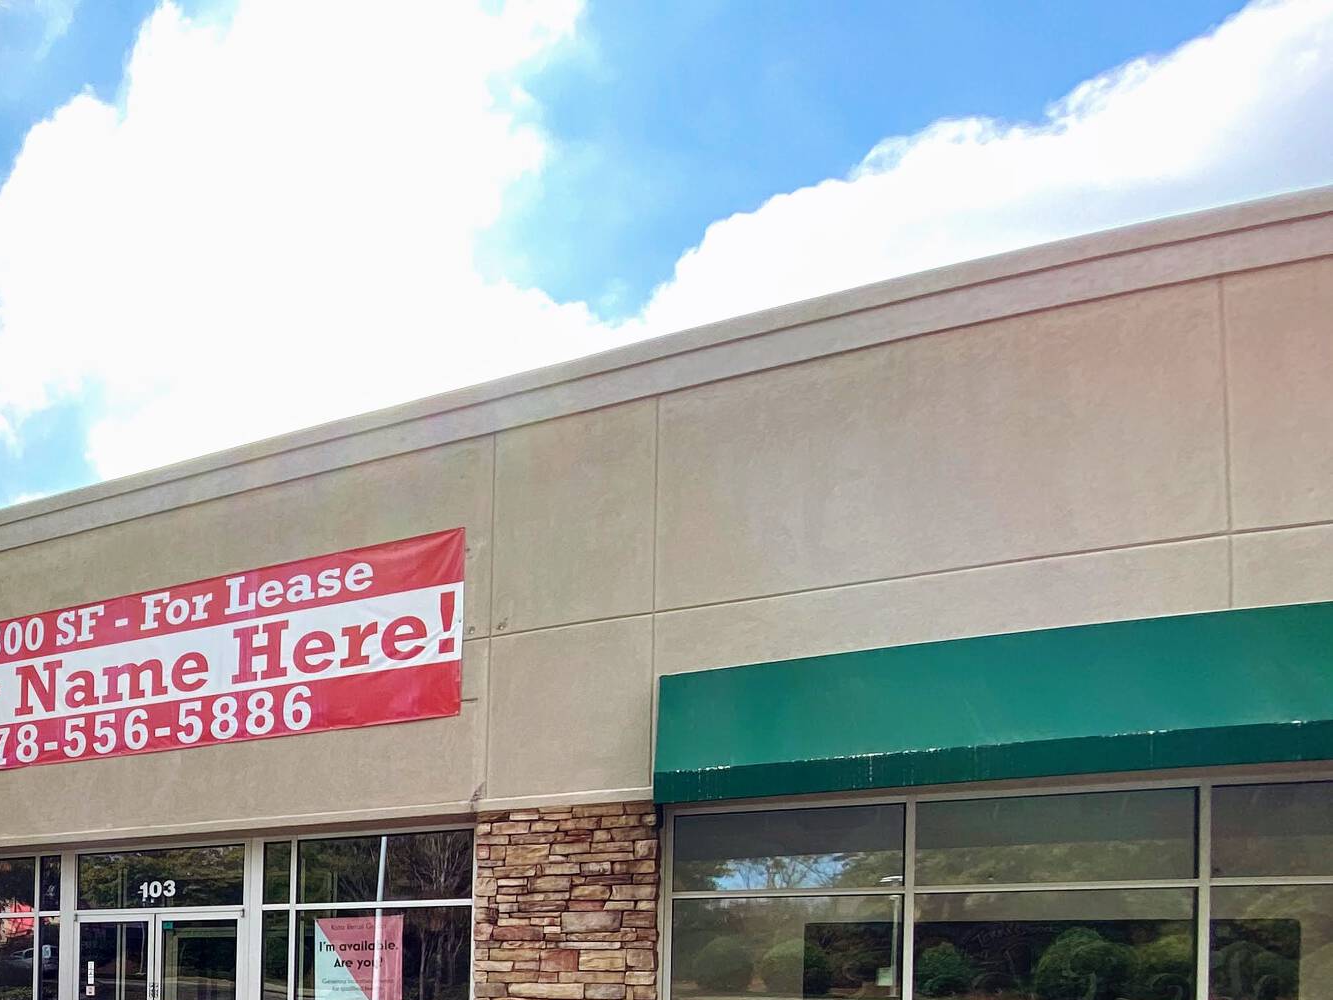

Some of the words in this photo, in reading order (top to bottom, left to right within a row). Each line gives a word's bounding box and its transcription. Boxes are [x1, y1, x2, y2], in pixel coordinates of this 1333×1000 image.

[56, 605, 104, 647] SF
[115, 618, 128, 628] -
[140, 591, 213, 631] For
[224, 562, 374, 616] Lease
[15, 651, 209, 717] Name
[231, 590, 456, 685] Here!
[139, 879, 176, 898] 103
[319, 941, 335, 952] I'm
[334, 958, 354, 968] Are
